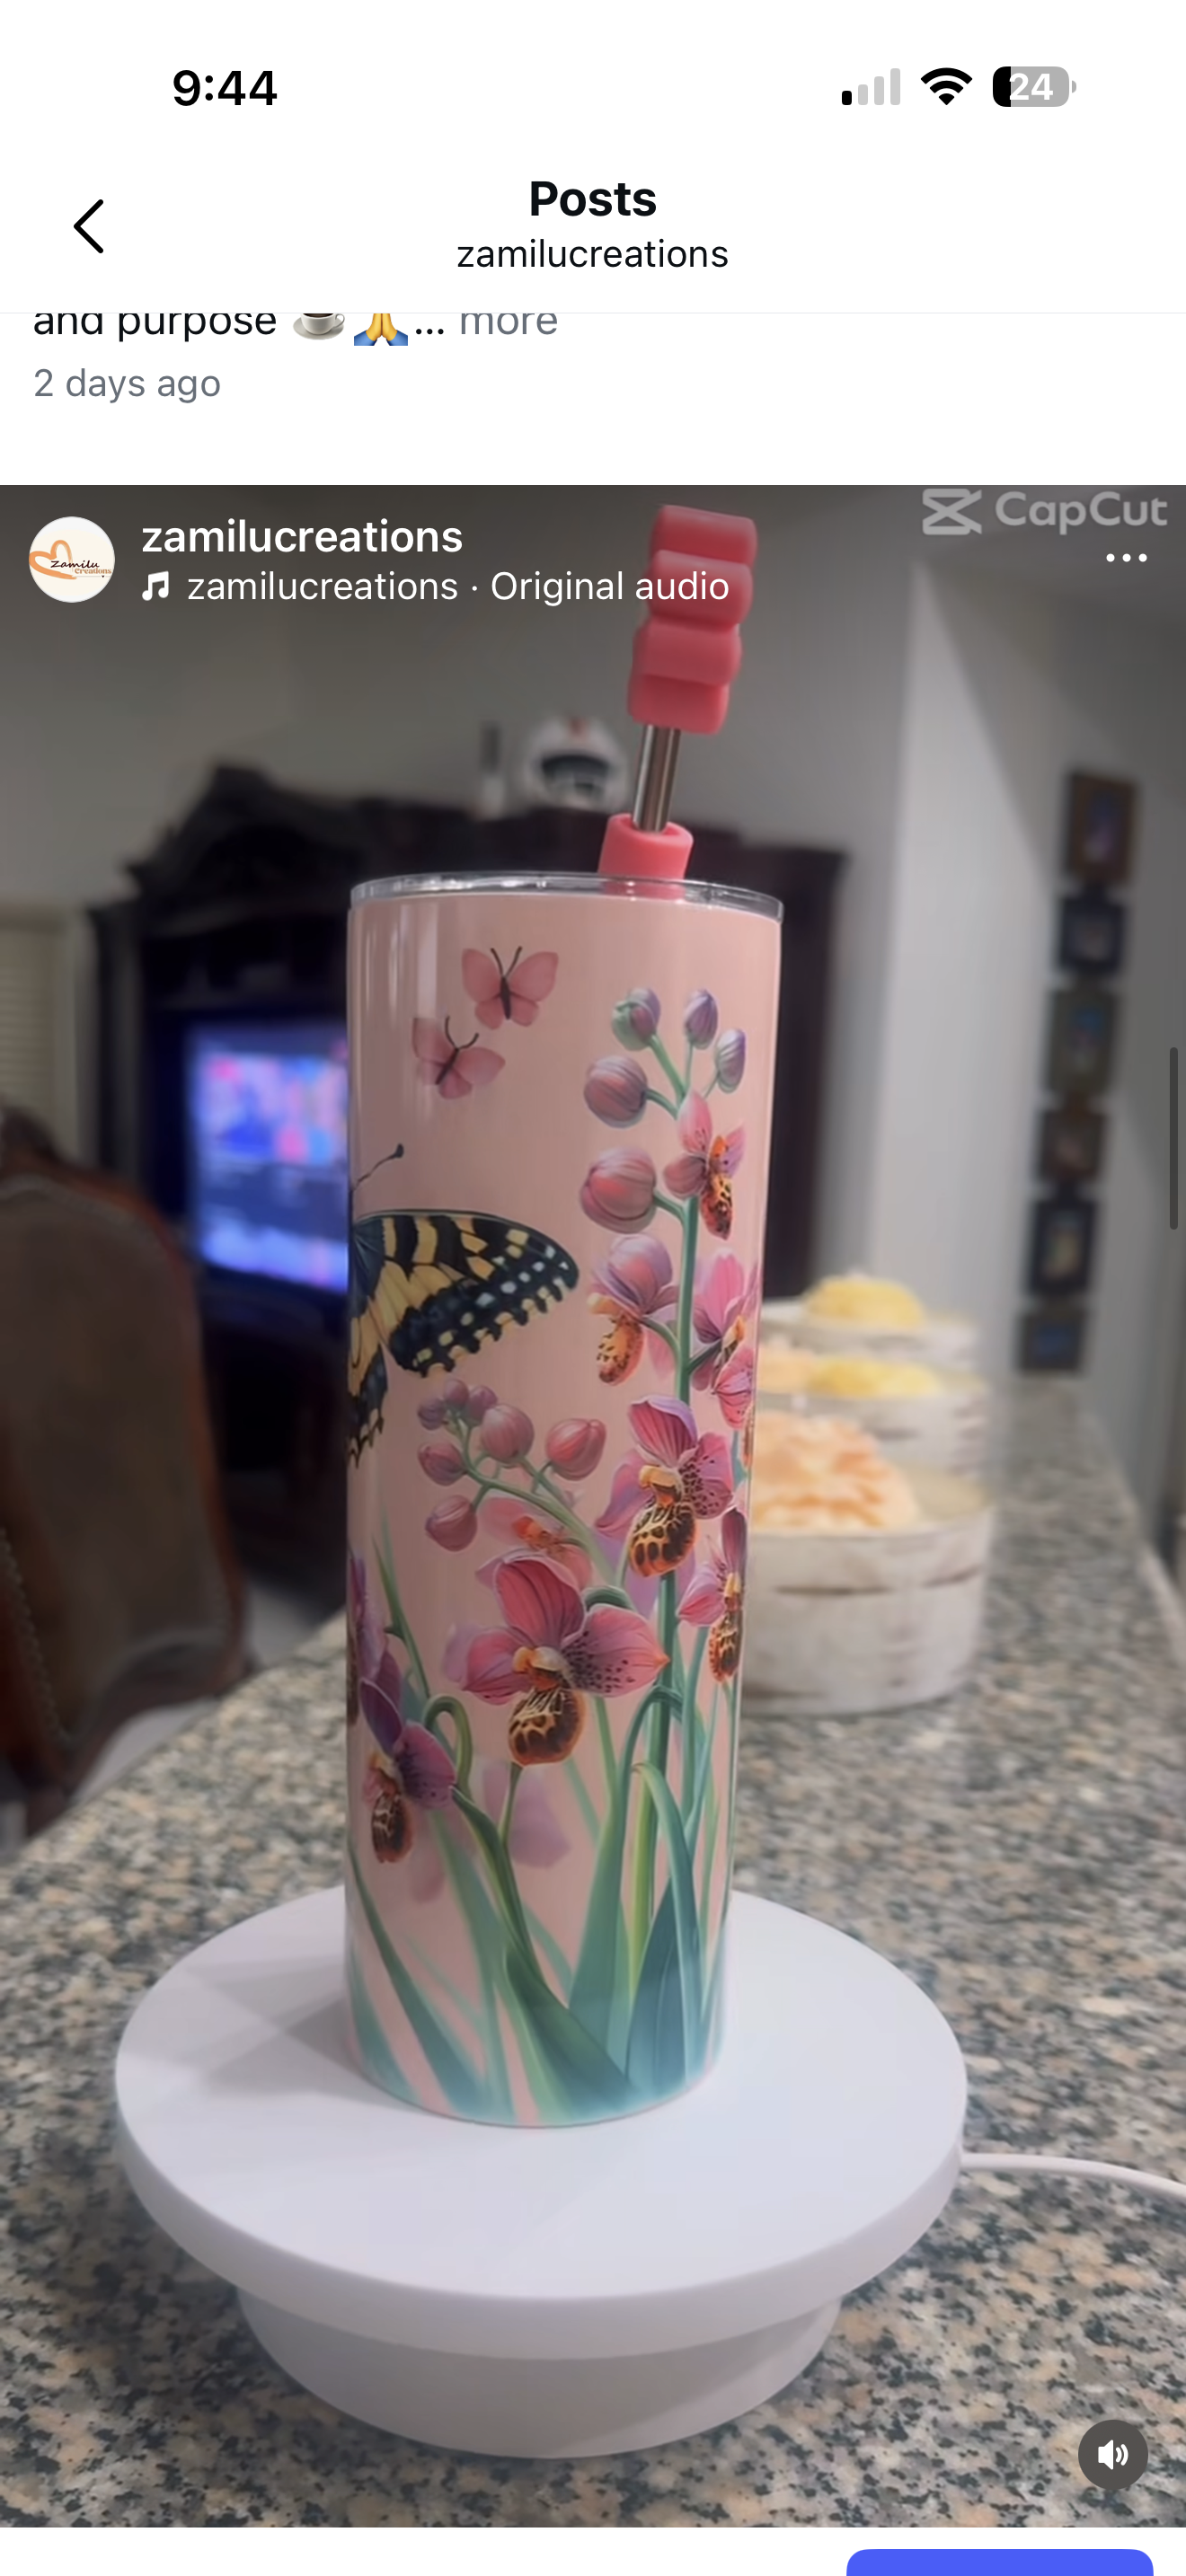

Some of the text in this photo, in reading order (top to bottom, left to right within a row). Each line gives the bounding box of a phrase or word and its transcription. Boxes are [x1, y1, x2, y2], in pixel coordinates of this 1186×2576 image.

[173, 69, 278, 107] 9:44
[1008, 73, 1054, 101] 24
[530, 181, 657, 217] Posts
[457, 238, 729, 268] zamilucreations
[33, 313, 103, 336] and
[119, 313, 277, 343] purpose
[461, 313, 558, 335] more
[34, 367, 221, 404] 2 days ago
